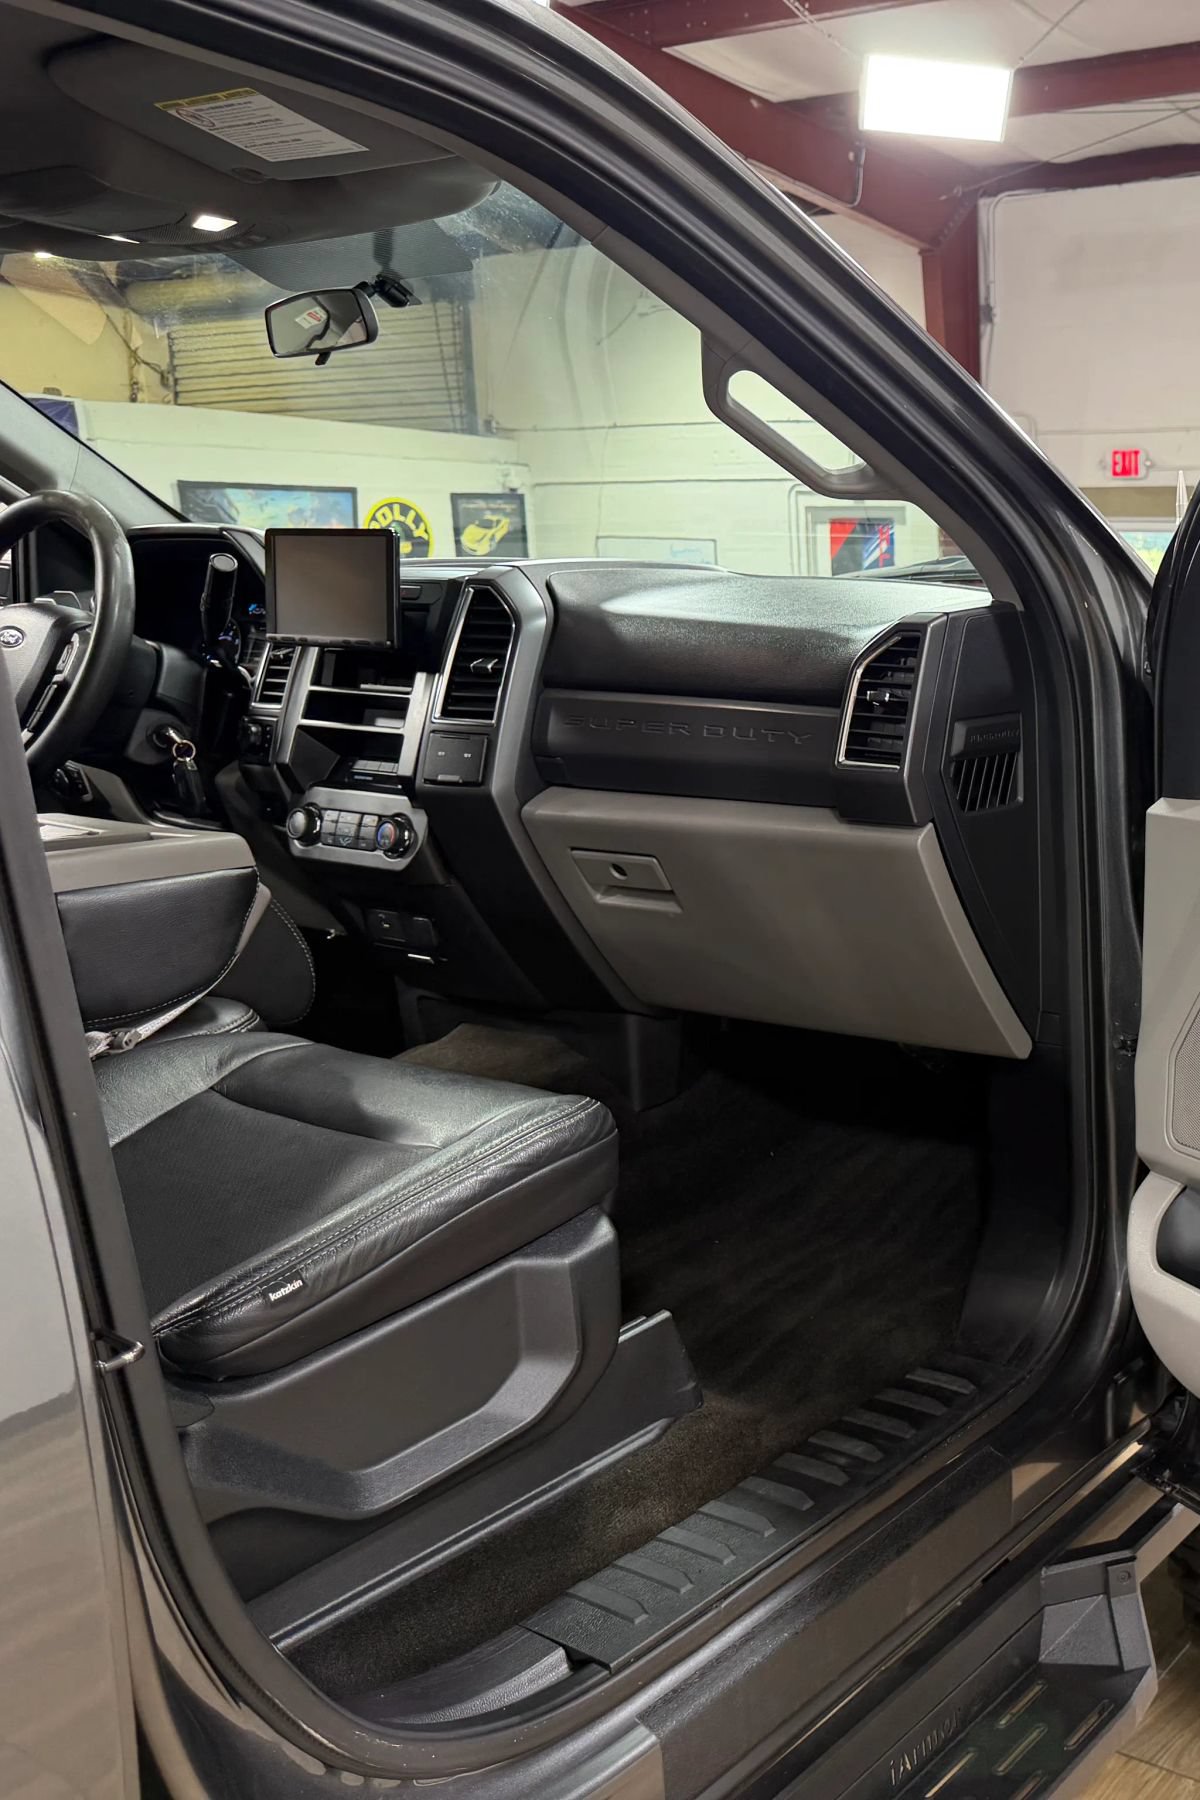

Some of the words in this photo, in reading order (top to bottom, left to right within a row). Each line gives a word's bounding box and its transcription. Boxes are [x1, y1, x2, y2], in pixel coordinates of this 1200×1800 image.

[1112, 449, 1140, 477] EXIT
[563, 714, 692, 736] SUPER
[702, 723, 813, 745] DUTY
[268, 1279, 303, 1302] katzkin
